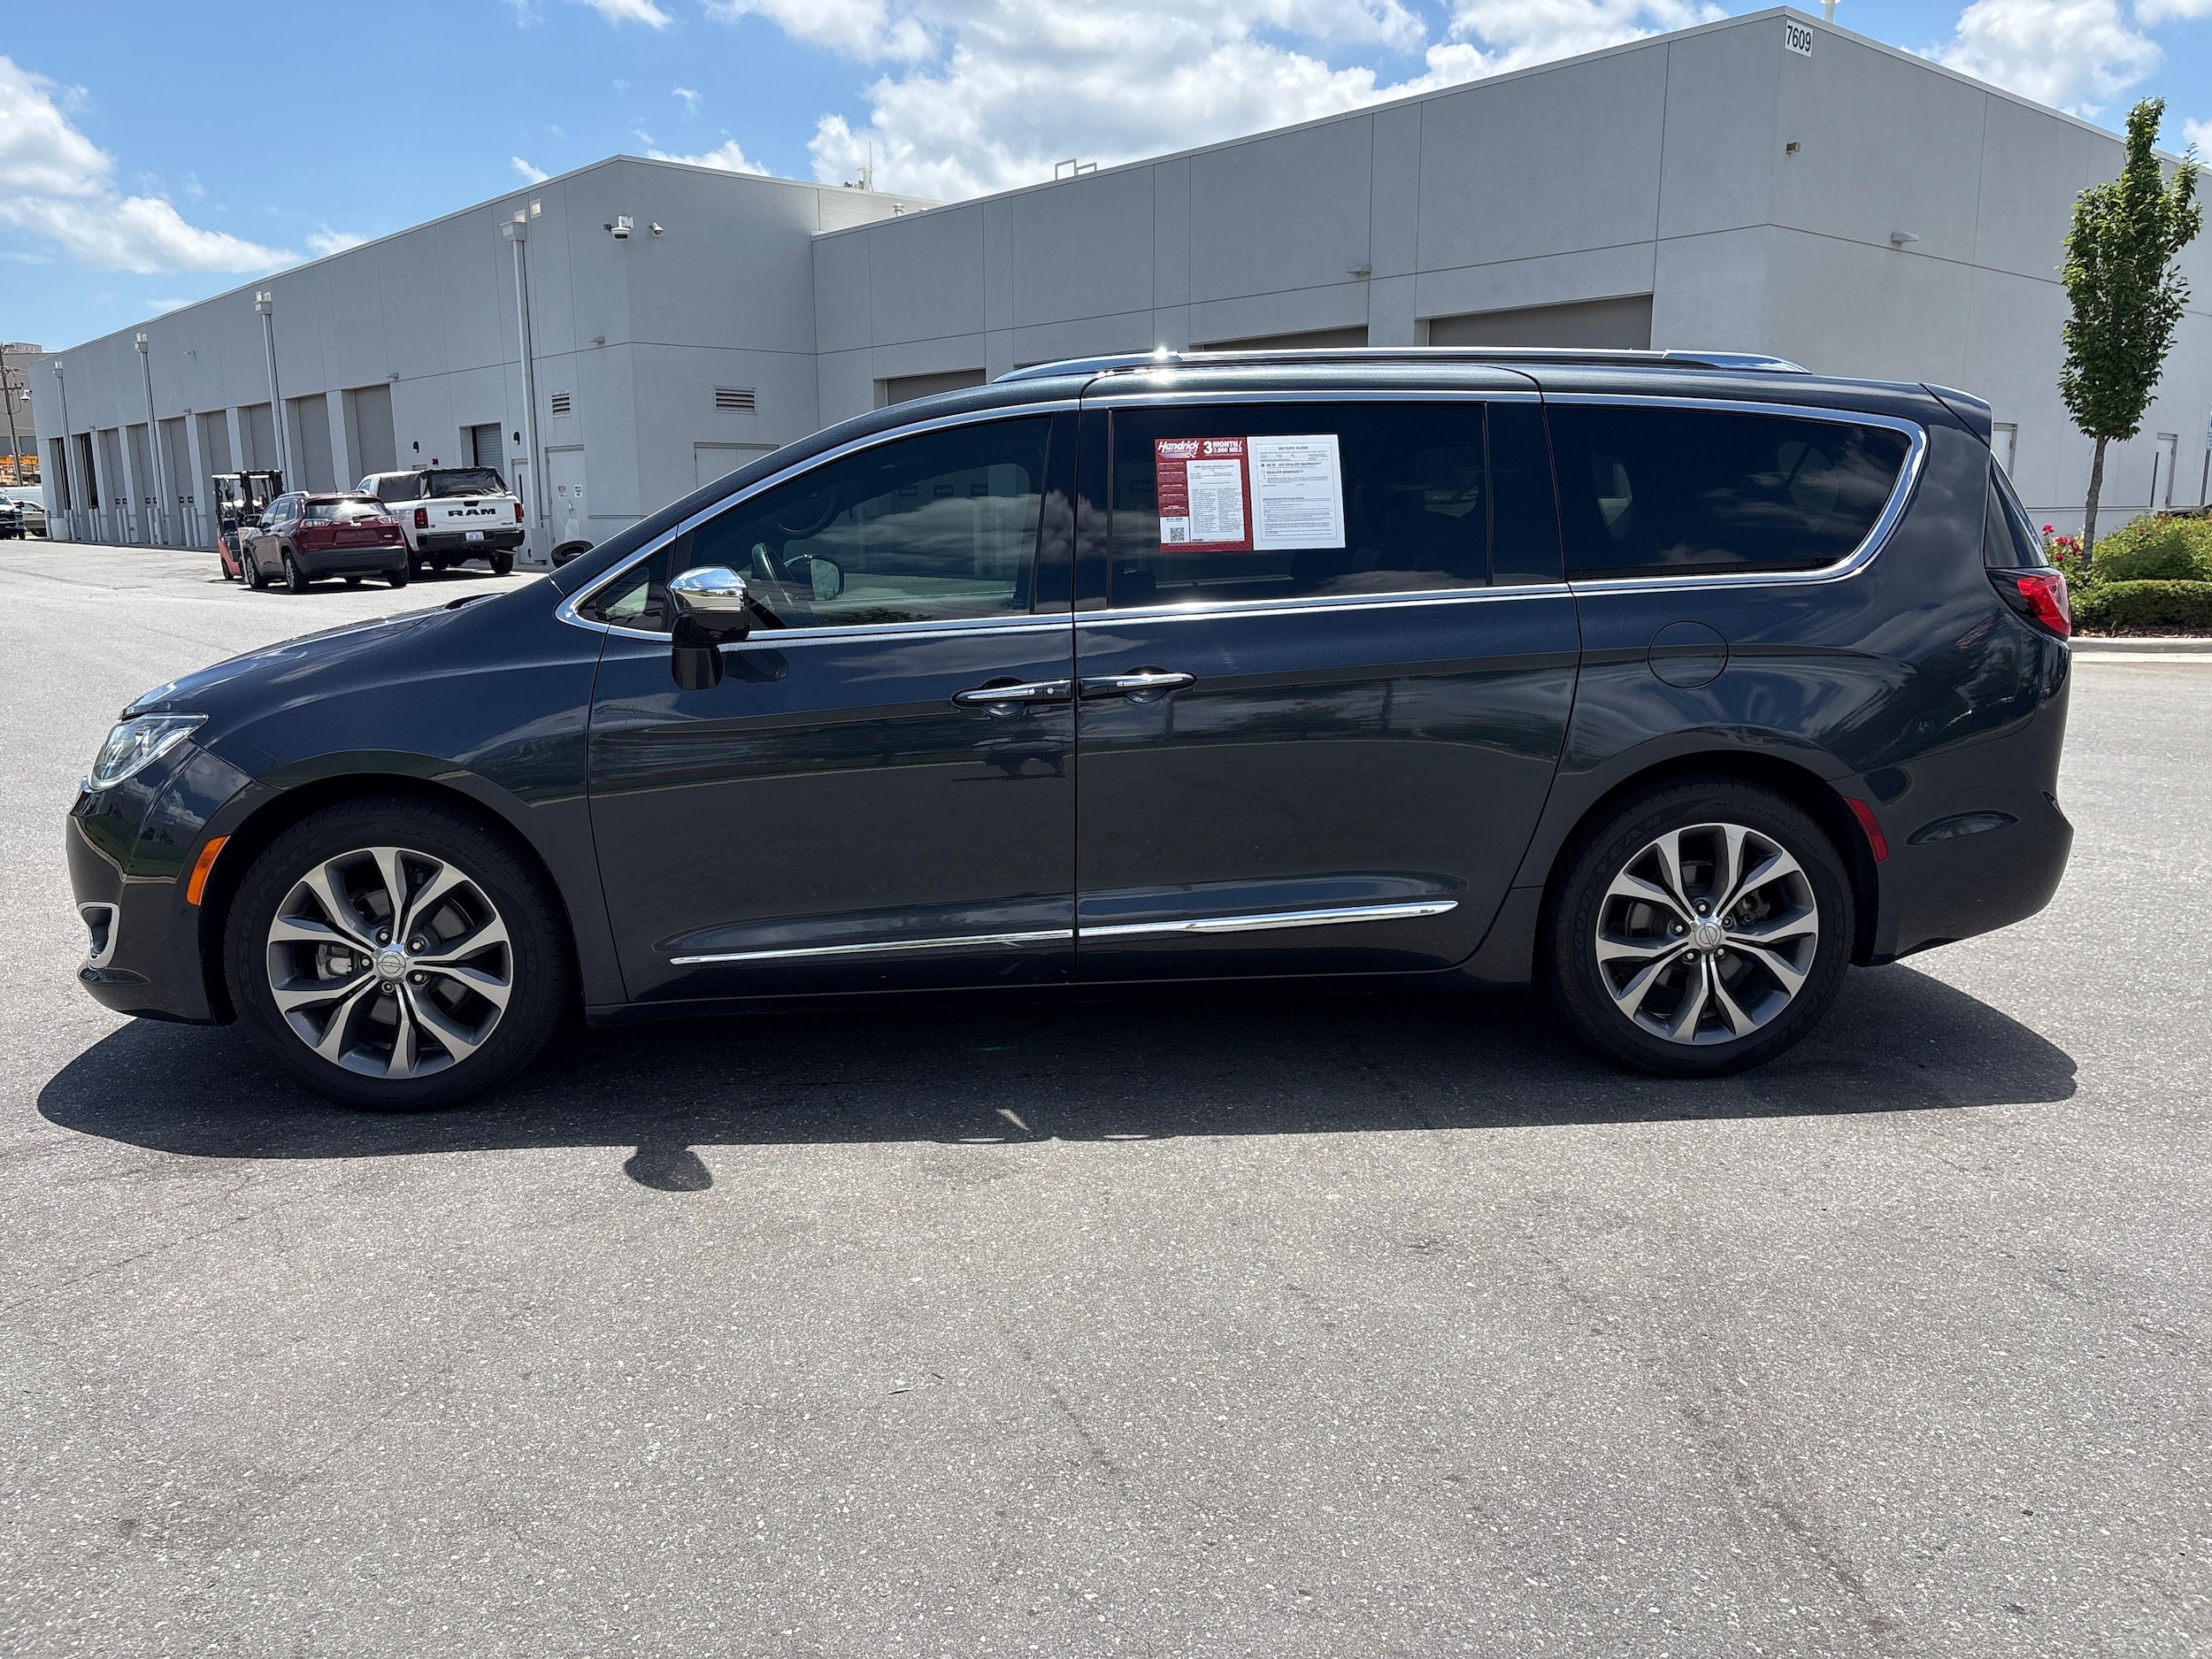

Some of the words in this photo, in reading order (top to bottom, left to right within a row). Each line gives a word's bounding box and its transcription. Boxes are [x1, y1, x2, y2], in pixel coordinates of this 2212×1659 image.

[1787, 25, 1811, 52] 7609
[1157, 441, 1199, 453] Hendrick
[1203, 441, 1213, 455] 3
[448, 508, 496, 517] RAM
[1574, 814, 1663, 972] GOODYEAR
